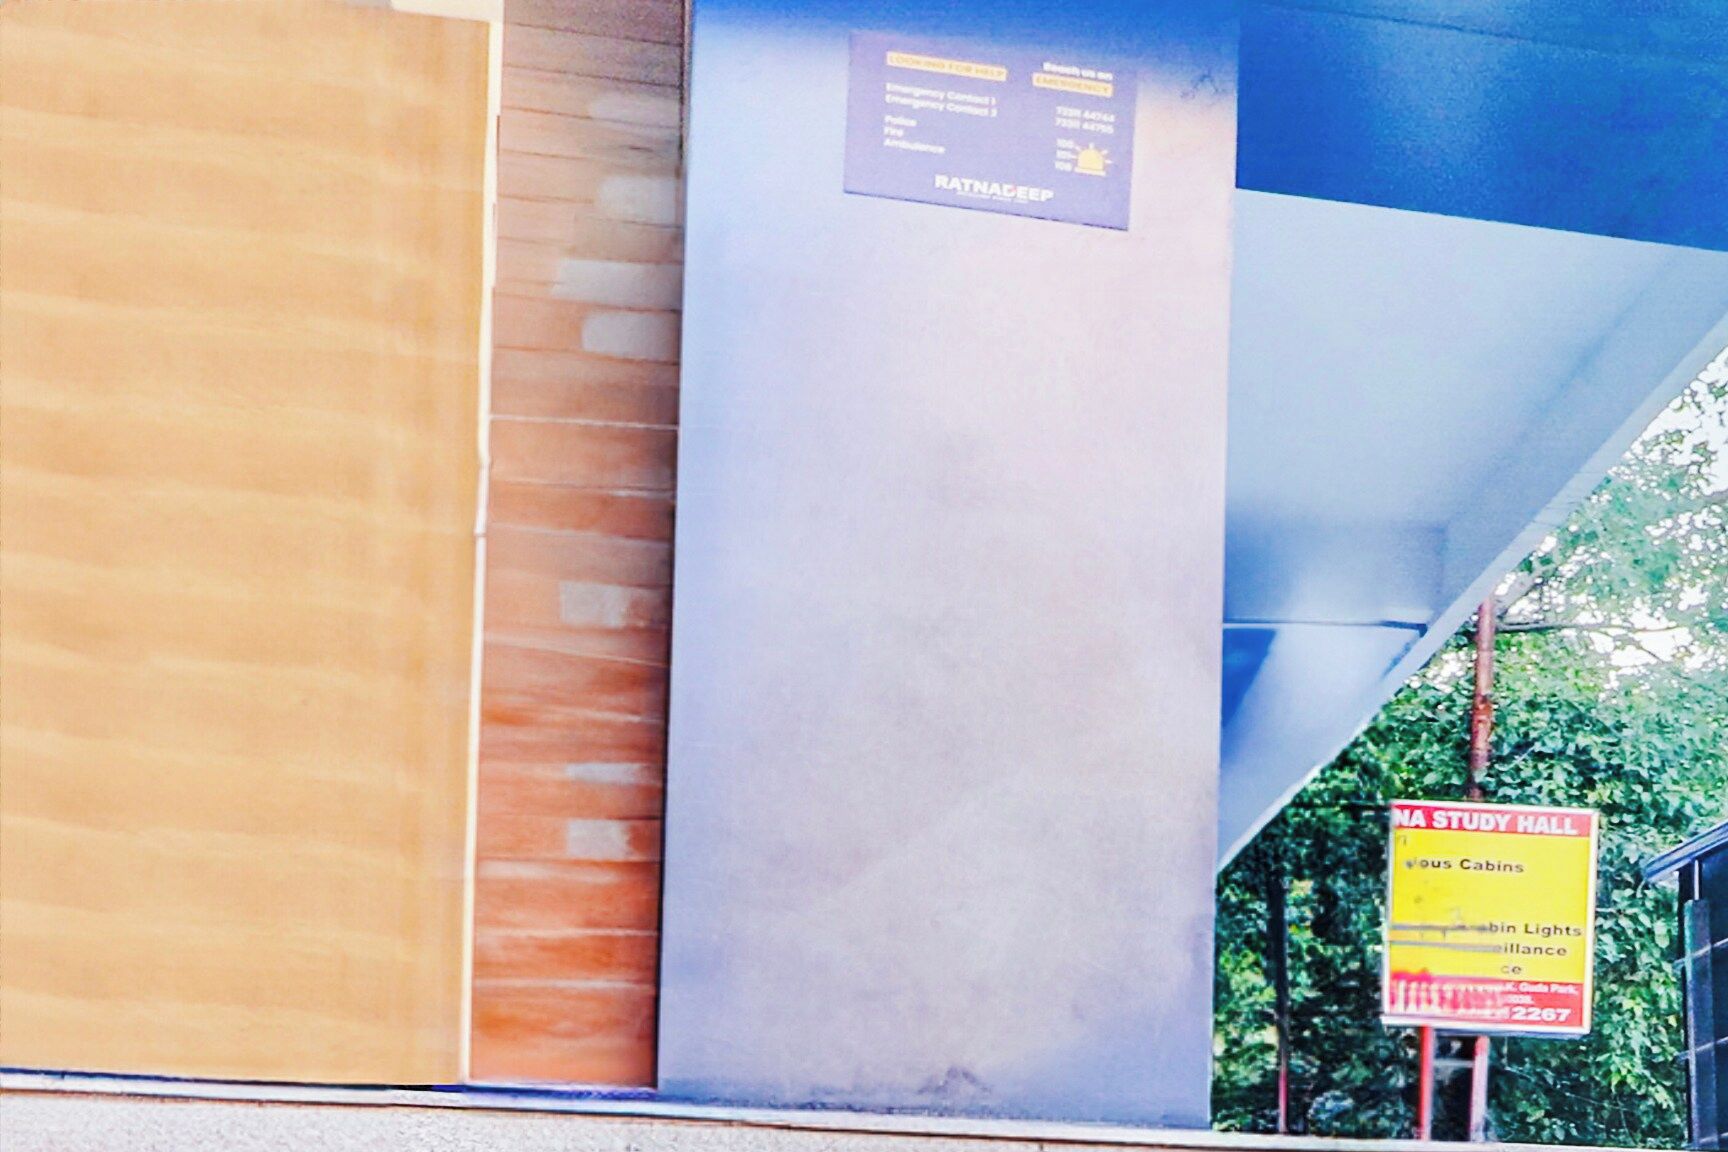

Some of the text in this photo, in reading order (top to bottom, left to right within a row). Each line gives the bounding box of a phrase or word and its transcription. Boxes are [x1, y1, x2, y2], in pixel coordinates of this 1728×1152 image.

[885, 83, 945, 101] Emergency
[946, 91, 989, 105] Contact
[885, 94, 945, 112] Emergency
[946, 102, 989, 117] Contact
[934, 174, 1055, 203] RATNADEEP
[1432, 810, 1511, 832] STUDY
[1517, 815, 1578, 836] HALL
[1460, 857, 1525, 873] Cabins
[1524, 923, 1583, 938] Lights
[1510, 1005, 1572, 1022] 2267
